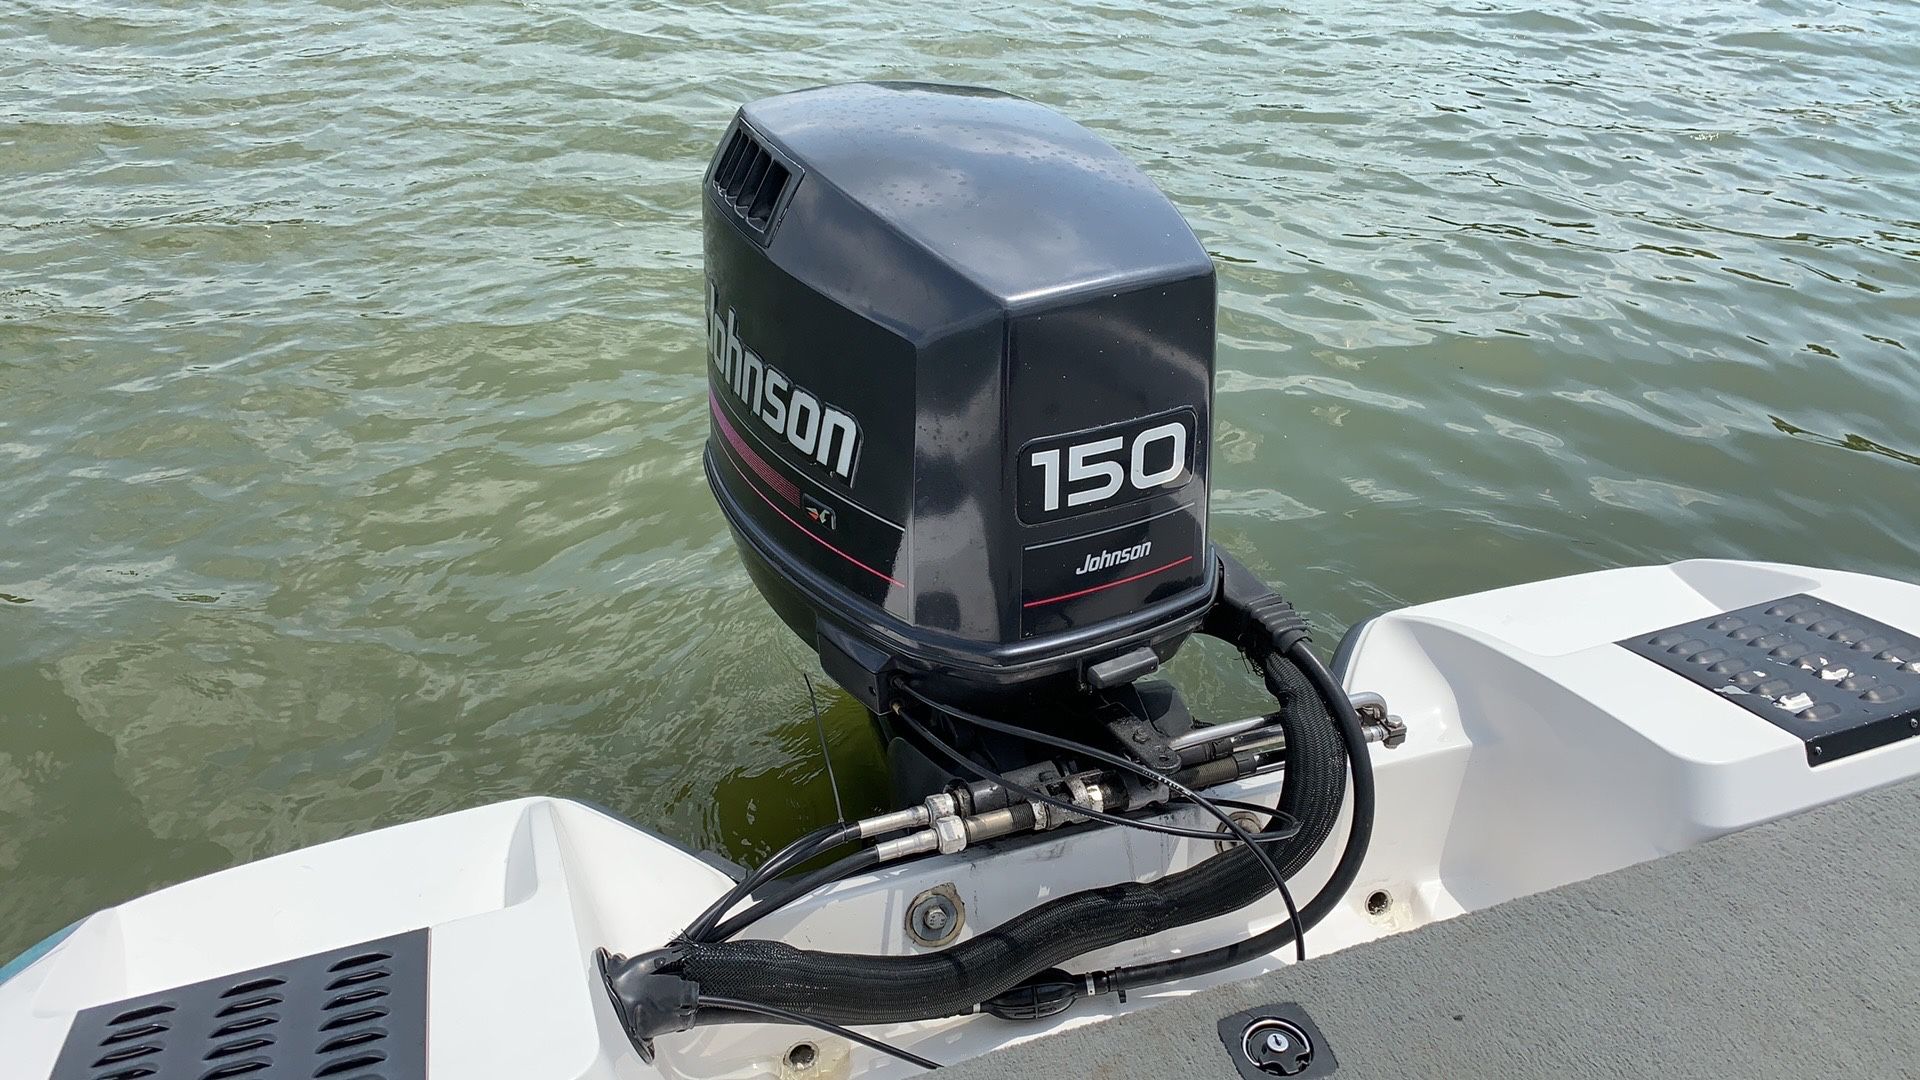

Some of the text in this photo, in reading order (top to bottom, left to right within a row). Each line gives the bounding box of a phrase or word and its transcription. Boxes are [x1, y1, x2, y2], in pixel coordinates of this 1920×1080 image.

[706, 282, 857, 478] Johnson
[1031, 422, 1187, 512] 150
[1075, 541, 1152, 575] Johnson
